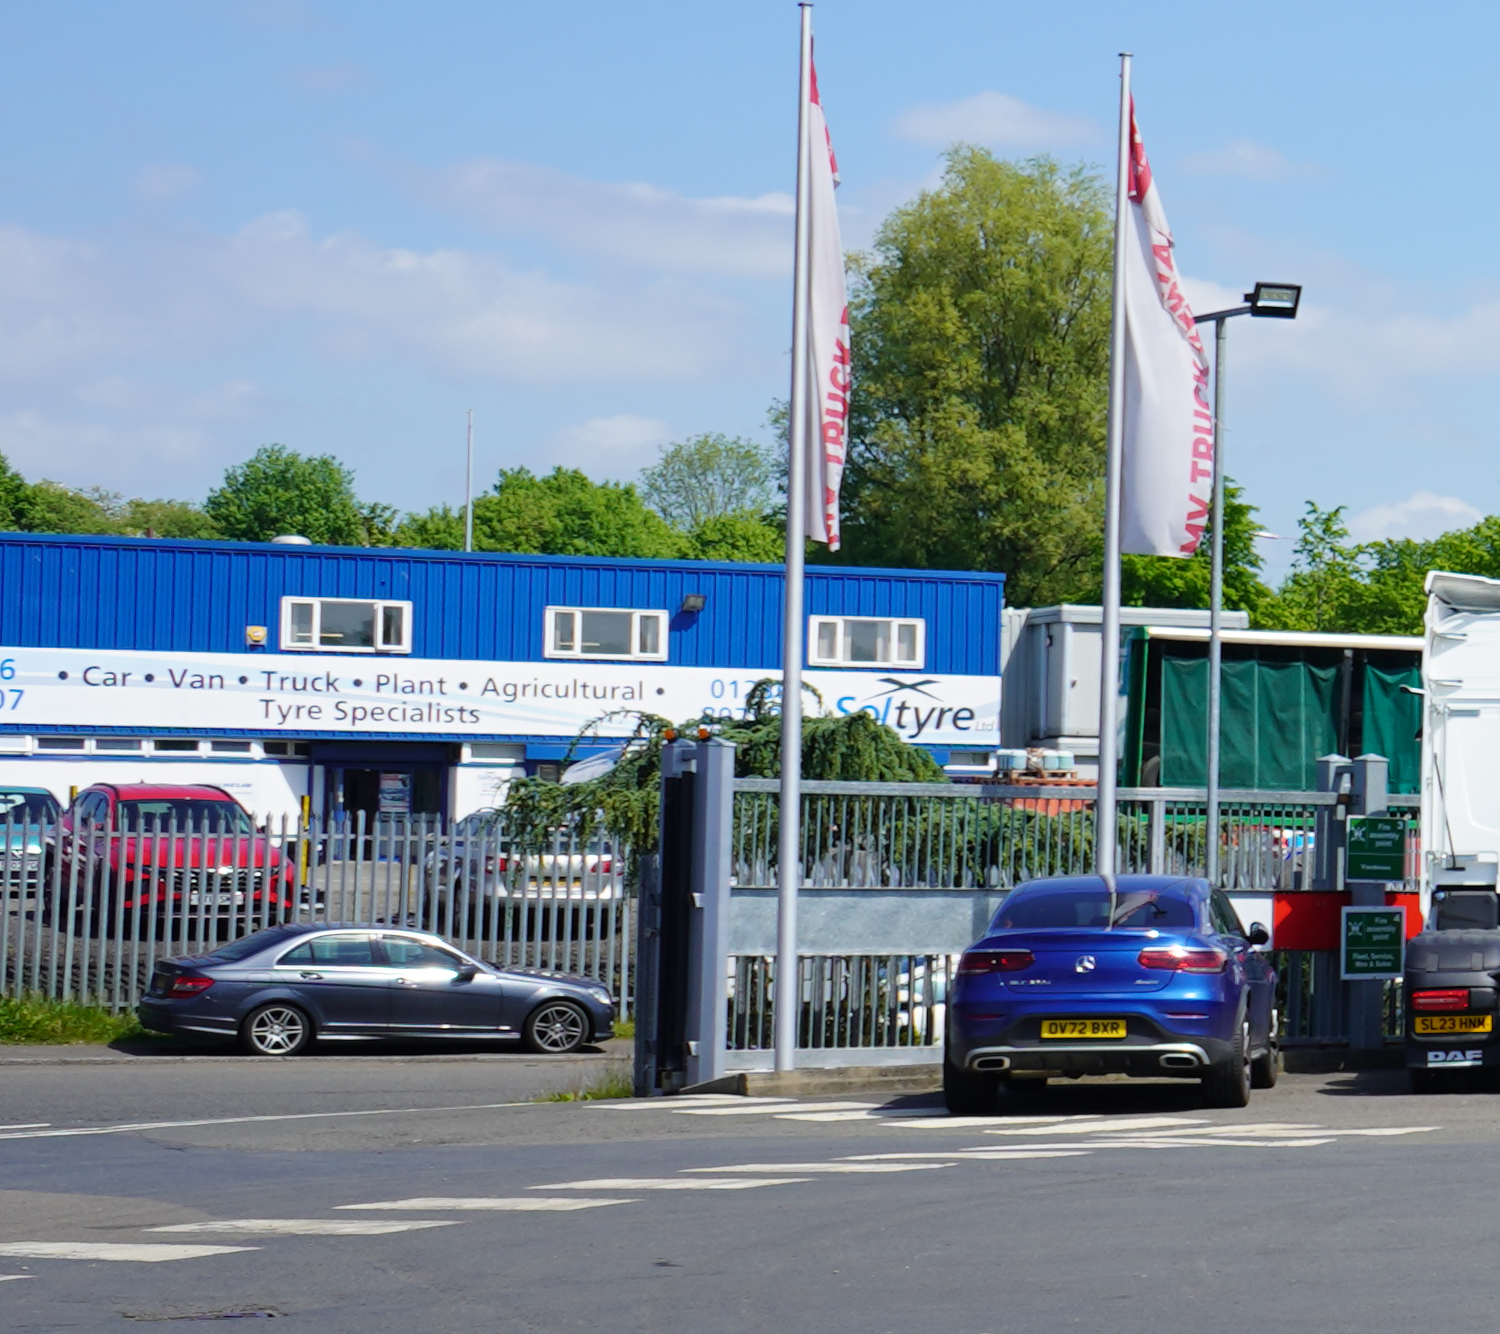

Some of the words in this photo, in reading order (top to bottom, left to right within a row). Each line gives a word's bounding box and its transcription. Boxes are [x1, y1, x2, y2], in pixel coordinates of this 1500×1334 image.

[1180, 494, 1209, 554] MV
[83, 666, 132, 687] Car
[168, 668, 224, 689] Van
[261, 670, 339, 693] Truck
[376, 673, 448, 695] Plant
[481, 677, 643, 703] Agricultural
[259, 699, 323, 725] Tyre
[335, 700, 480, 726] Specialists
[1049, 1022, 1087, 1034] OV72
[1091, 1022, 1120, 1034] BXR
[1421, 1018, 1456, 1030] SL23
[1427, 1049, 1483, 1062] DAF
